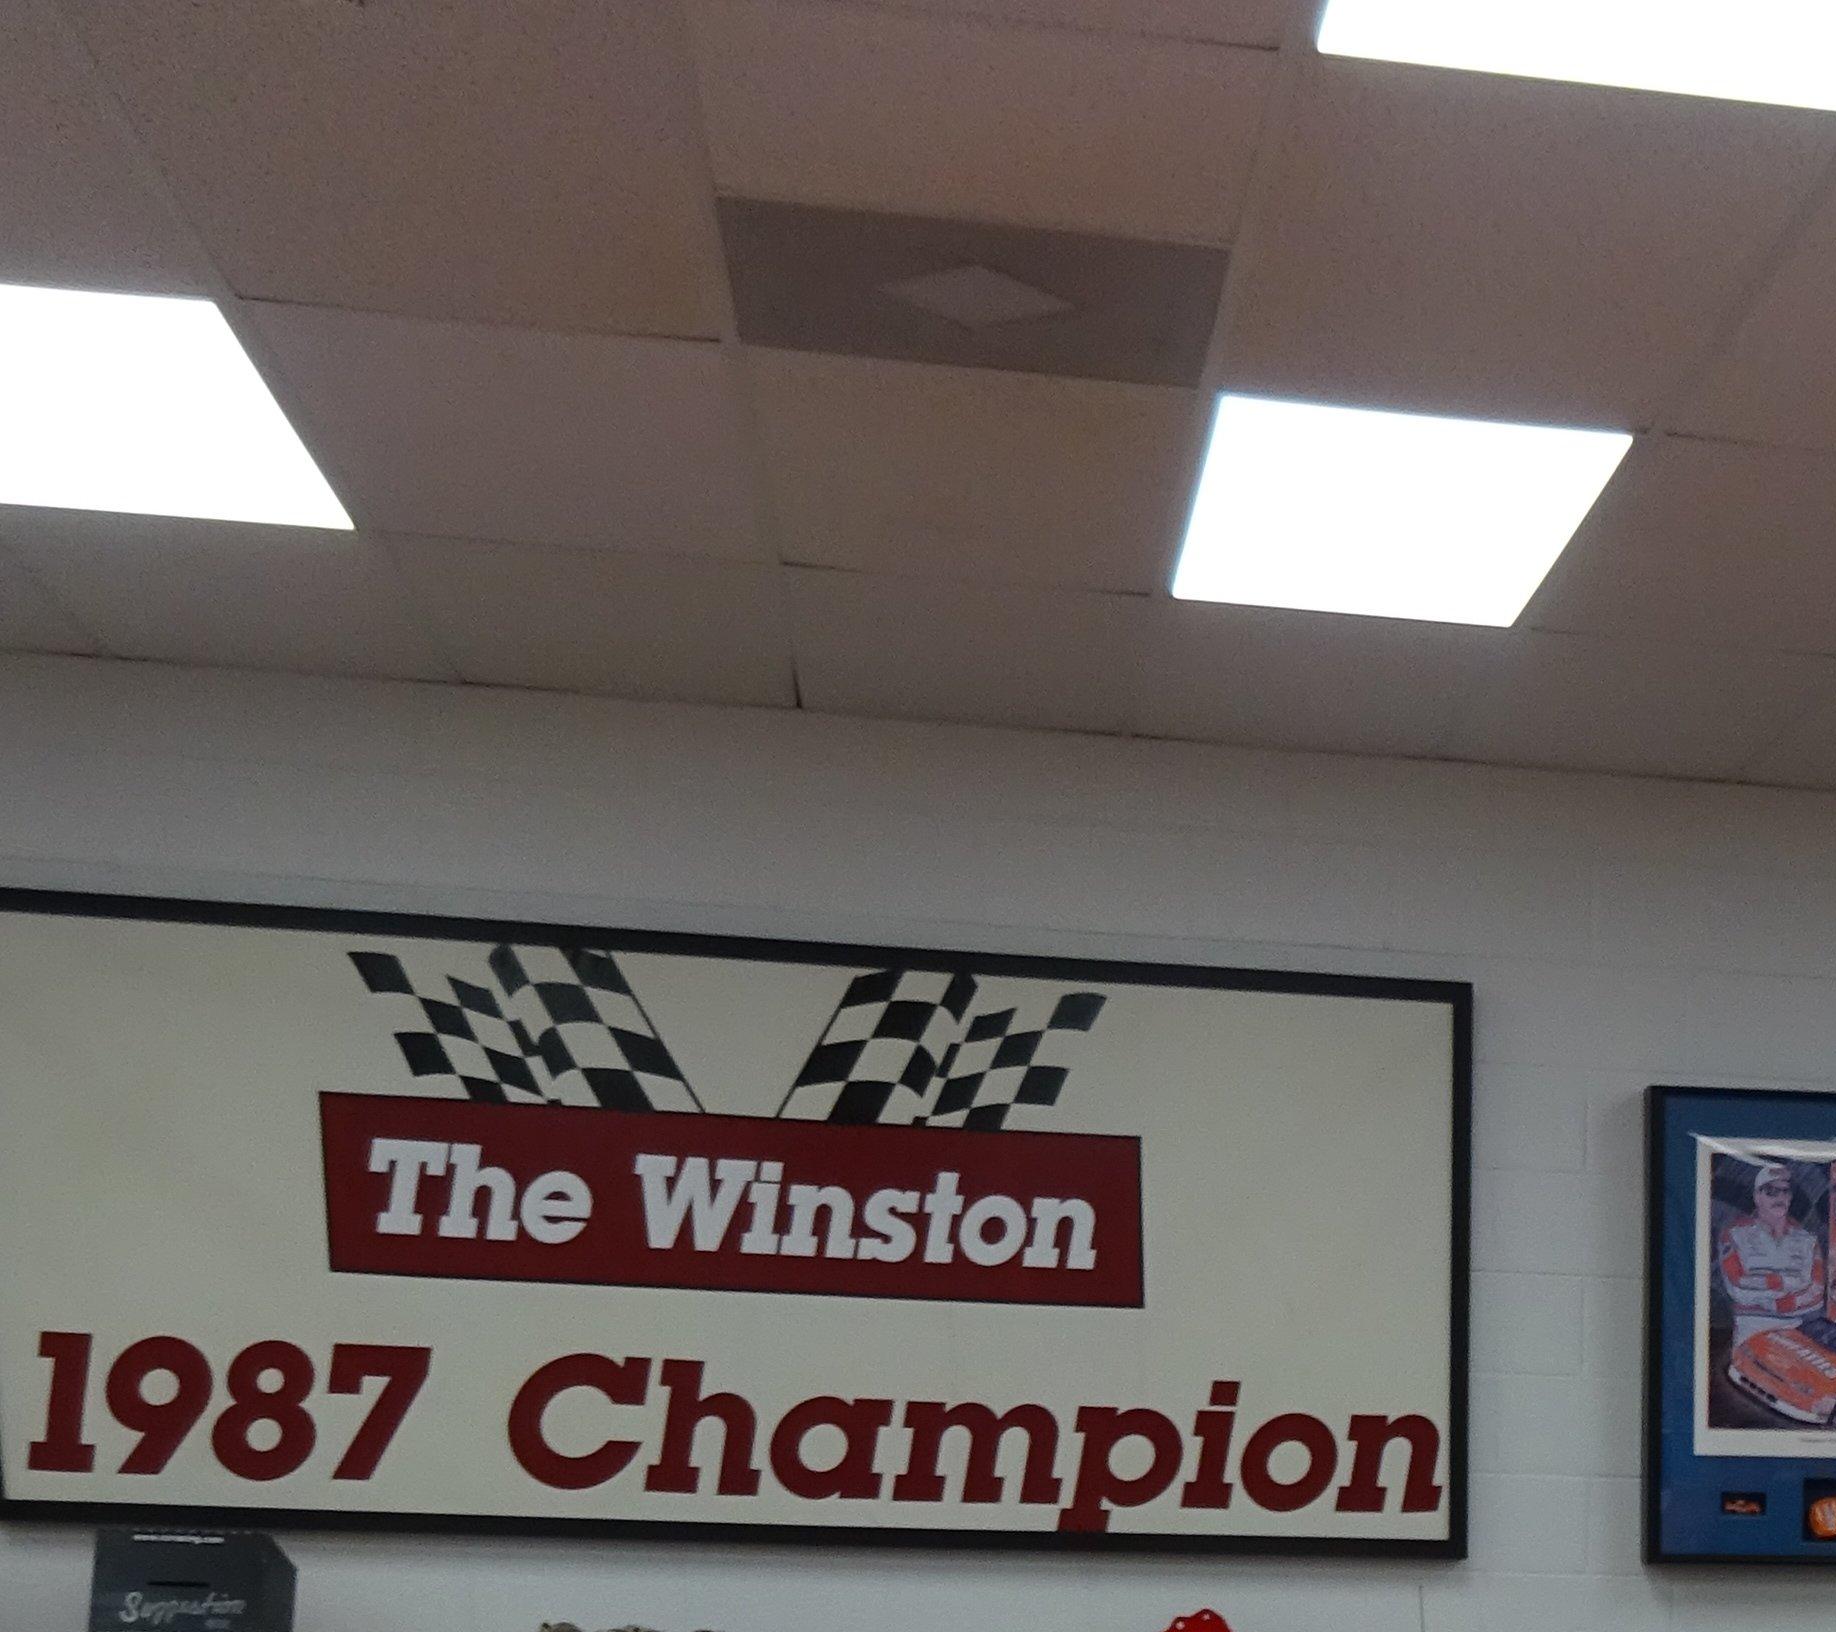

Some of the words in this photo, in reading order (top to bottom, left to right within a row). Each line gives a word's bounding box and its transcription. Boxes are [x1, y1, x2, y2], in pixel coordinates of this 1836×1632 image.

[367, 1136, 595, 1245] The
[634, 1153, 1099, 1272] Winston
[27, 1331, 432, 1482] 1987
[507, 1352, 1444, 1533] Champion
